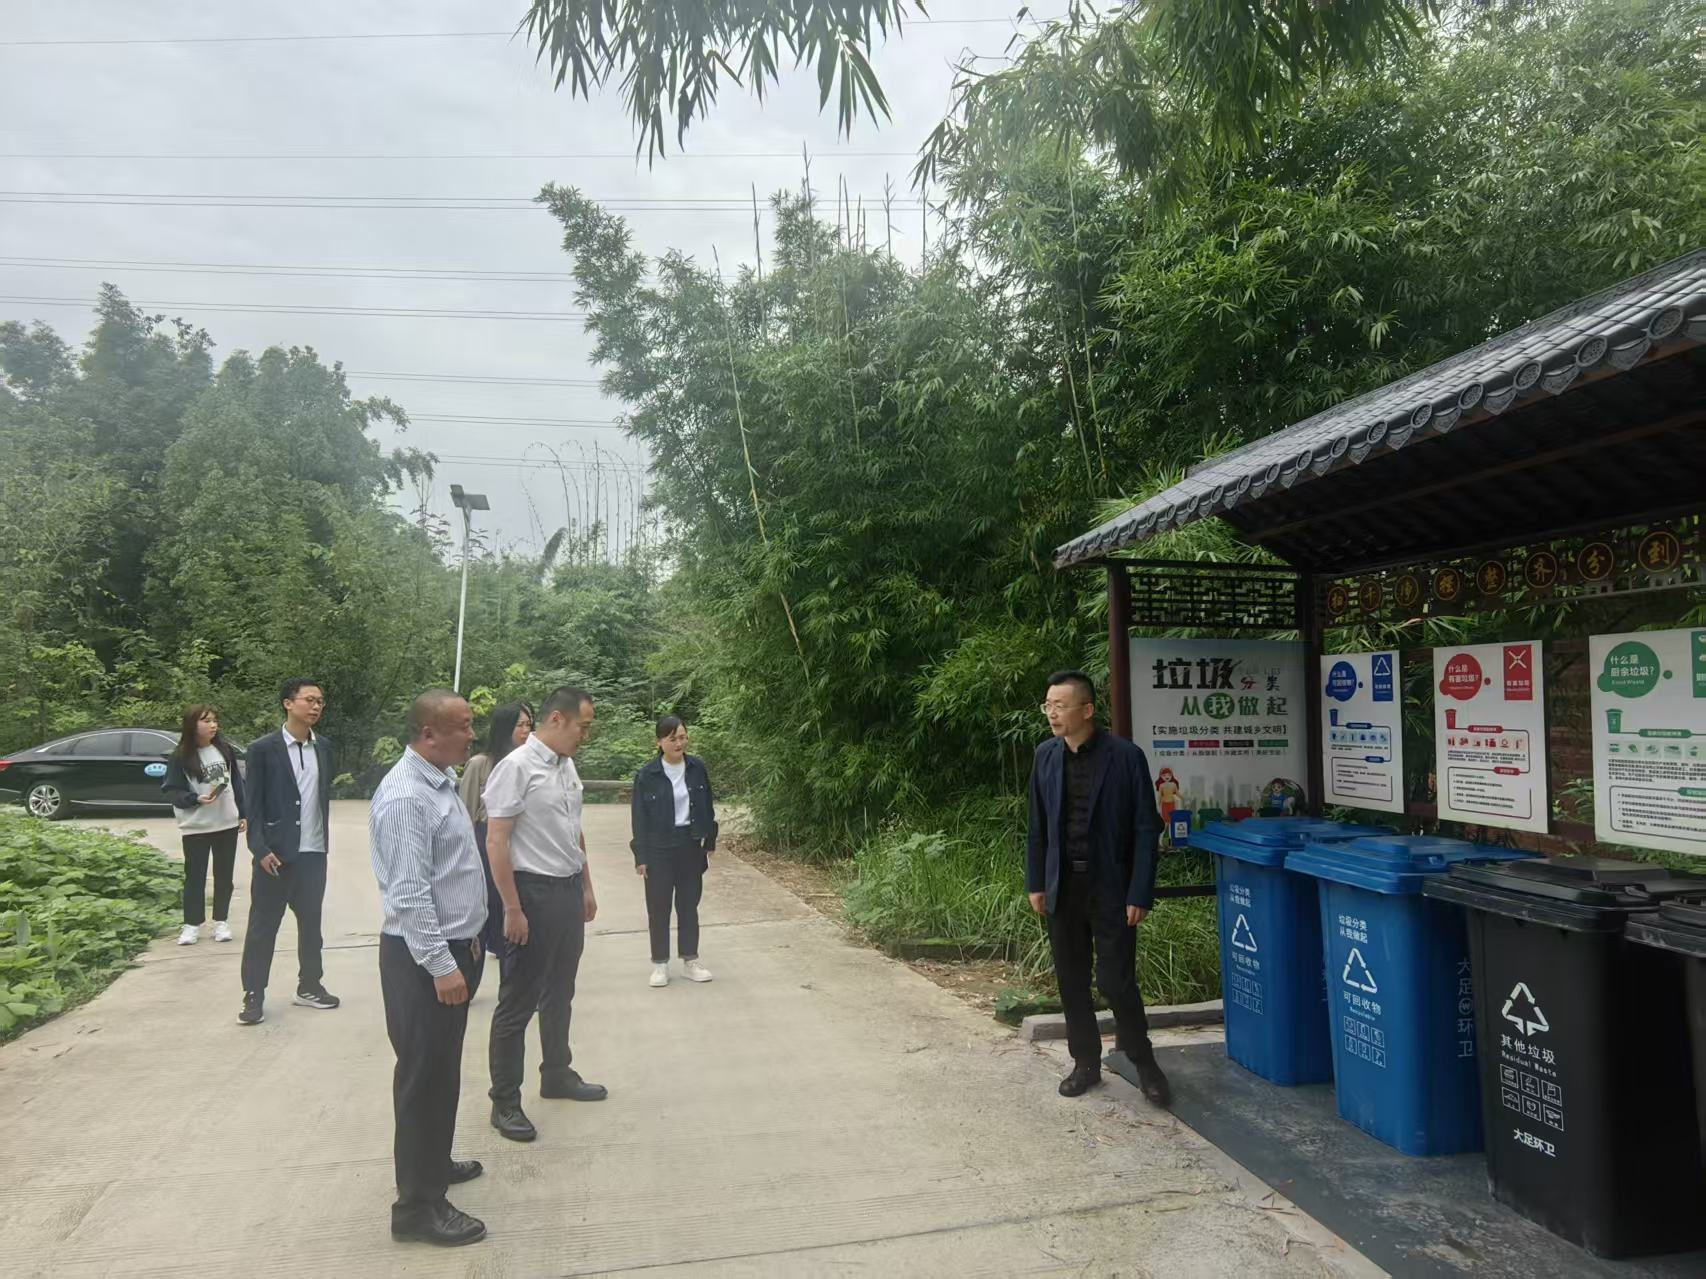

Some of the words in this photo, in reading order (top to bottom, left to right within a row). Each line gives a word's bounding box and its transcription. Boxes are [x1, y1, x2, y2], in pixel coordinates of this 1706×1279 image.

[1610, 654, 1639, 665] 什么是
[1152, 658, 1280, 691] 垃圾分类
[1180, 696, 1288, 716] 从我做起
[1338, 914, 1367, 931] 垃圾分类
[1339, 925, 1369, 944] 从我做起
[1343, 990, 1381, 1014] 可回收物
[1500, 1033, 1557, 1066] 其他垃圾
[1501, 1049, 1532, 1068] Residual
[1513, 1127, 1556, 1158] 大足环卫
